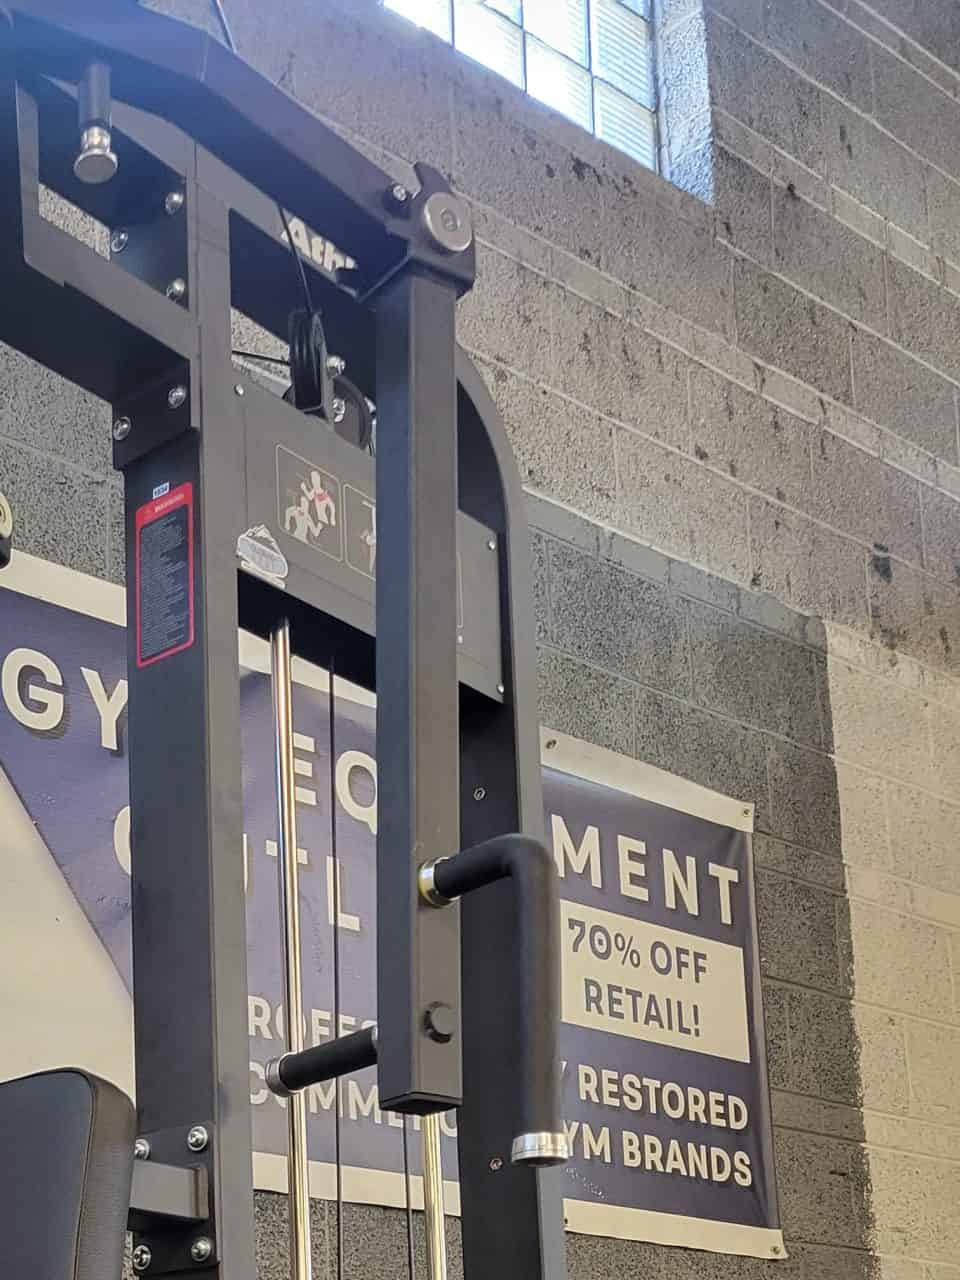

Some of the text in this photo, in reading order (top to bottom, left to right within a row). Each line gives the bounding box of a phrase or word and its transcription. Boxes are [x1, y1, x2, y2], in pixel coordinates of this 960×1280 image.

[568, 918, 707, 983] 70% OFF
[584, 977, 700, 1037] RETAIL!
[578, 1065, 748, 1130] RESTORED
[562, 1119, 753, 1188] YM BRANDS
